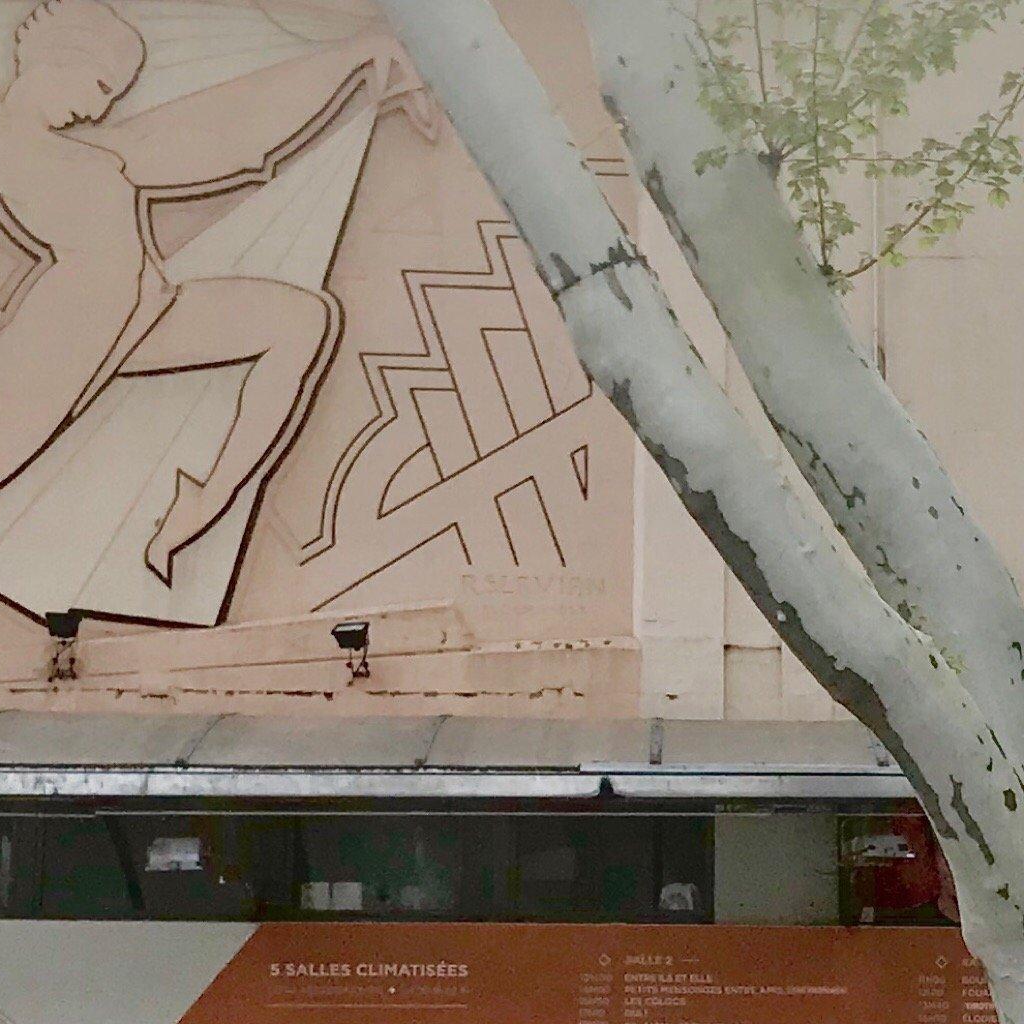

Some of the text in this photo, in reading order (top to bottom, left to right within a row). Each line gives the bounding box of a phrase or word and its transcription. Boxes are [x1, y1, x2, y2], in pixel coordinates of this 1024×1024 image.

[270, 960, 469, 977] 5 SALLES CLIMATISÉES
